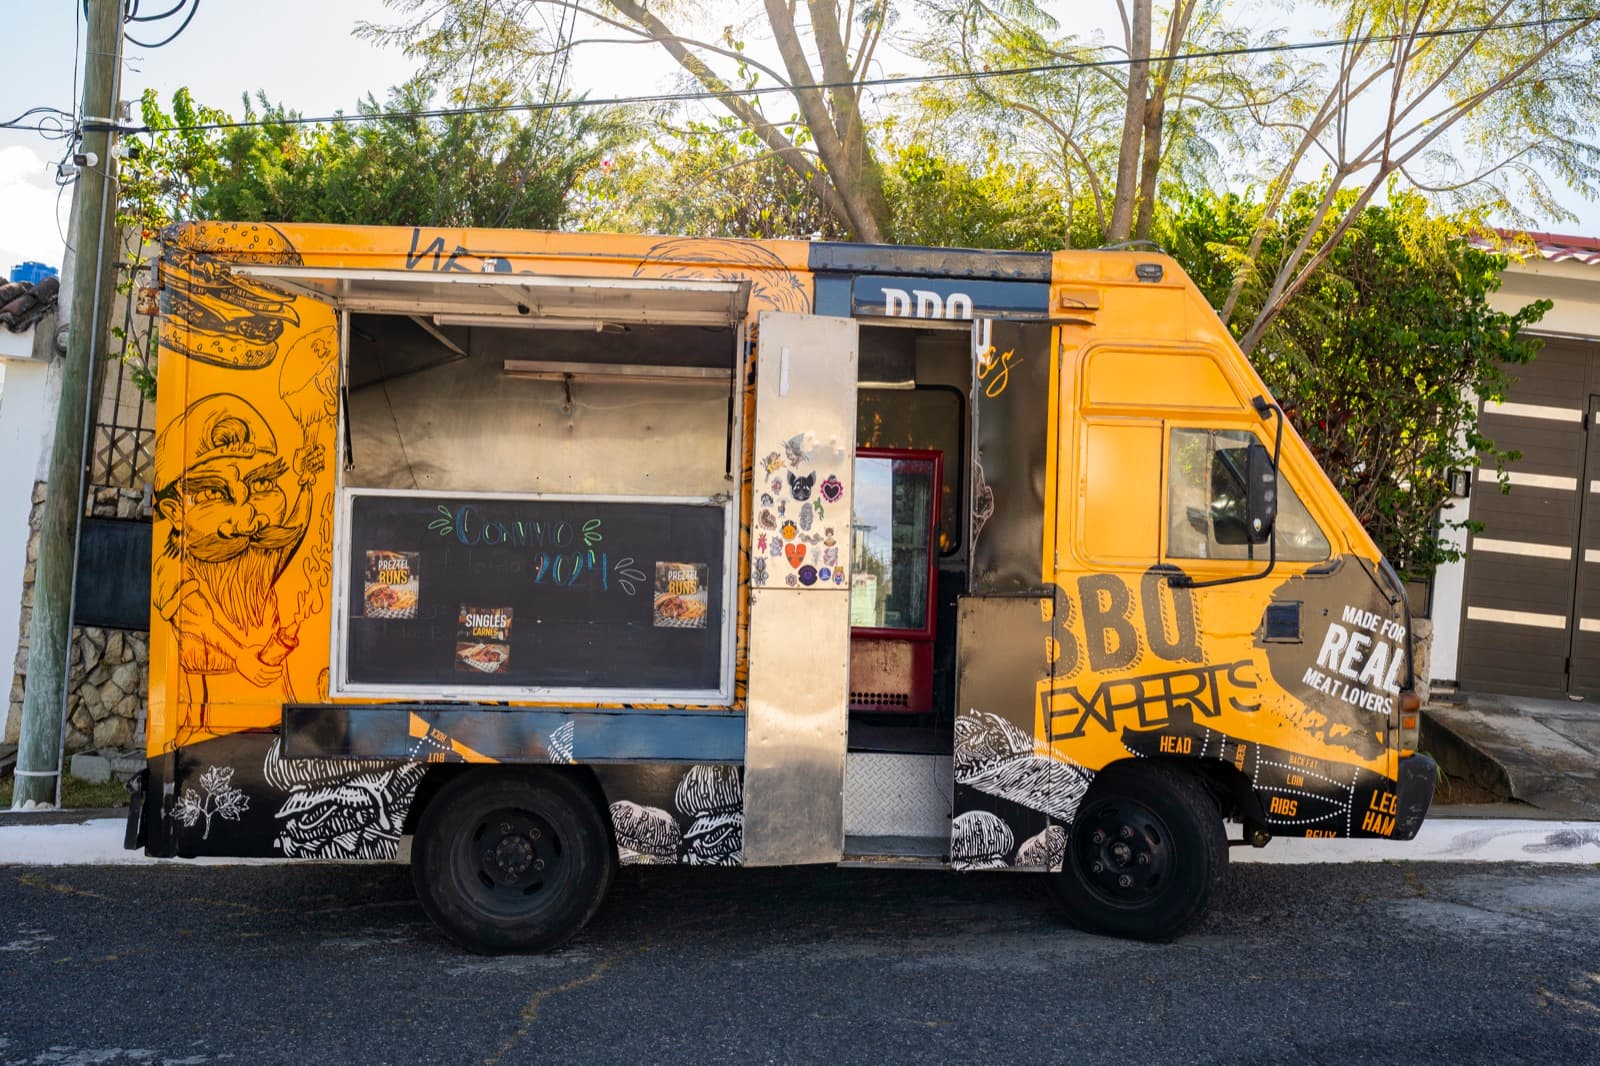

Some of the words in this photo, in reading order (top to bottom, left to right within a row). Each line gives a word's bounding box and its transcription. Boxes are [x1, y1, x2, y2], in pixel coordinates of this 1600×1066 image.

[378, 570, 408, 585] BUNS
[533, 550, 609, 591] 2024
[668, 579, 698, 595] BUNS
[465, 613, 507, 628] SINGLES
[1034, 564, 1208, 680] BBQ
[1341, 605, 1381, 633] MADE
[1380, 618, 1406, 643] FOR
[1316, 622, 1404, 697] REAL
[1040, 659, 1262, 743] EXPERTS
[1302, 667, 1342, 697] MEAT
[1340, 684, 1393, 715] LOVERS
[1160, 735, 1192, 754] HEAD
[1286, 773, 1305, 788] LOIN
[1269, 796, 1298, 817] RIBS
[1369, 789, 1398, 816] LEG
[1361, 810, 1396, 837] HAM
